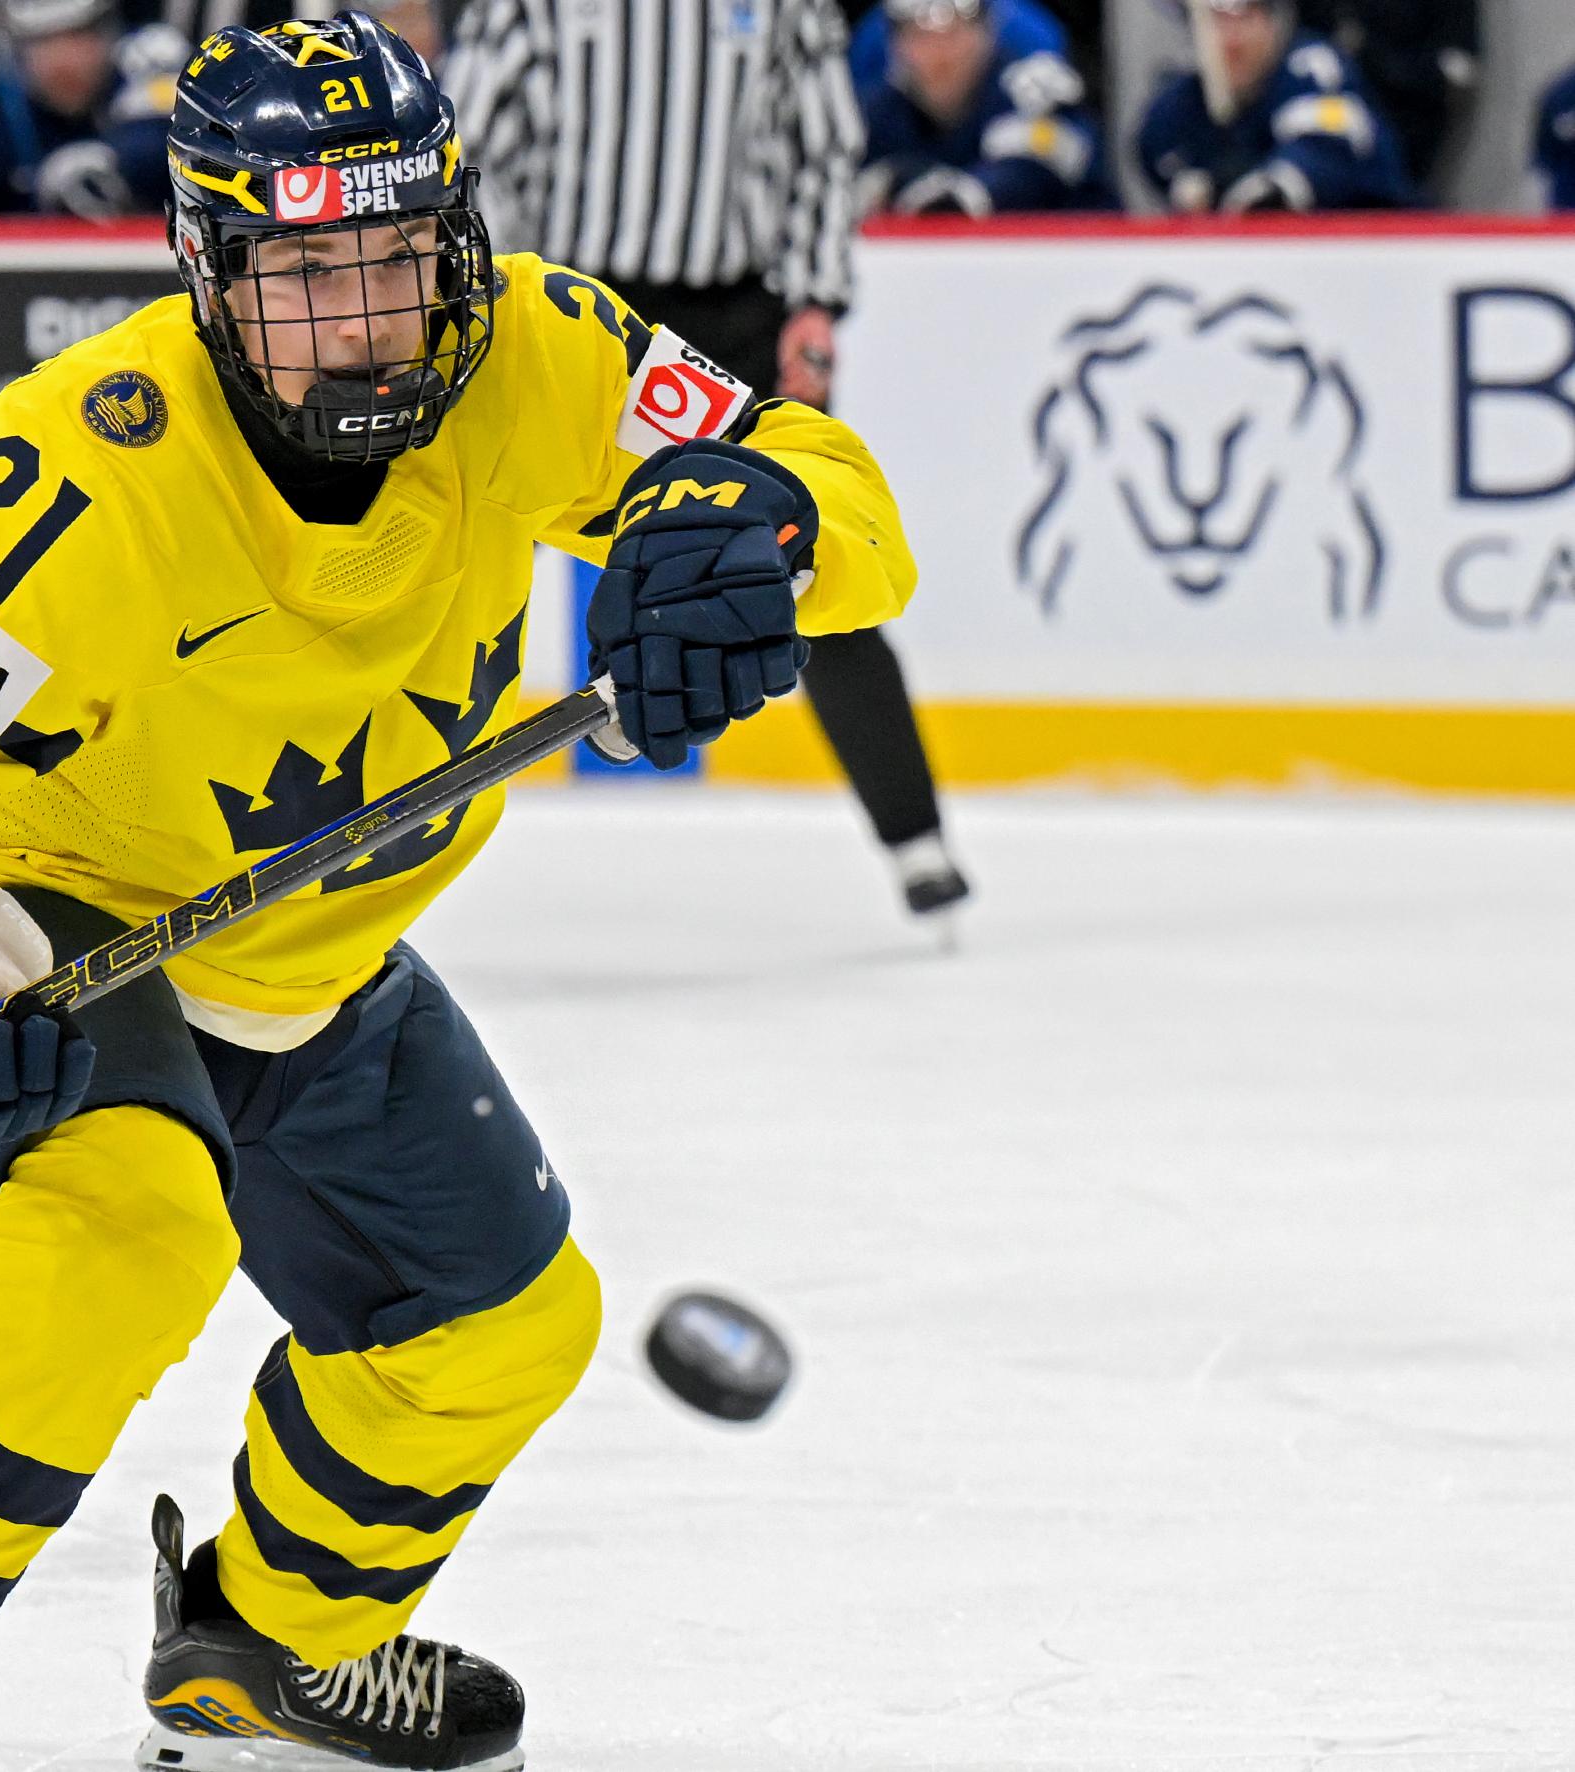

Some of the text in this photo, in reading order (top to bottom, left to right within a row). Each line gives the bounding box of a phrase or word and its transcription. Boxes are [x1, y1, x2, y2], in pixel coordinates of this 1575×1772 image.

[320, 75, 371, 113] 21
[319, 140, 399, 164] CCM
[339, 150, 439, 193] SVENSKA
[341, 186, 400, 217] SPEL
[337, 405, 424, 432] CCM
